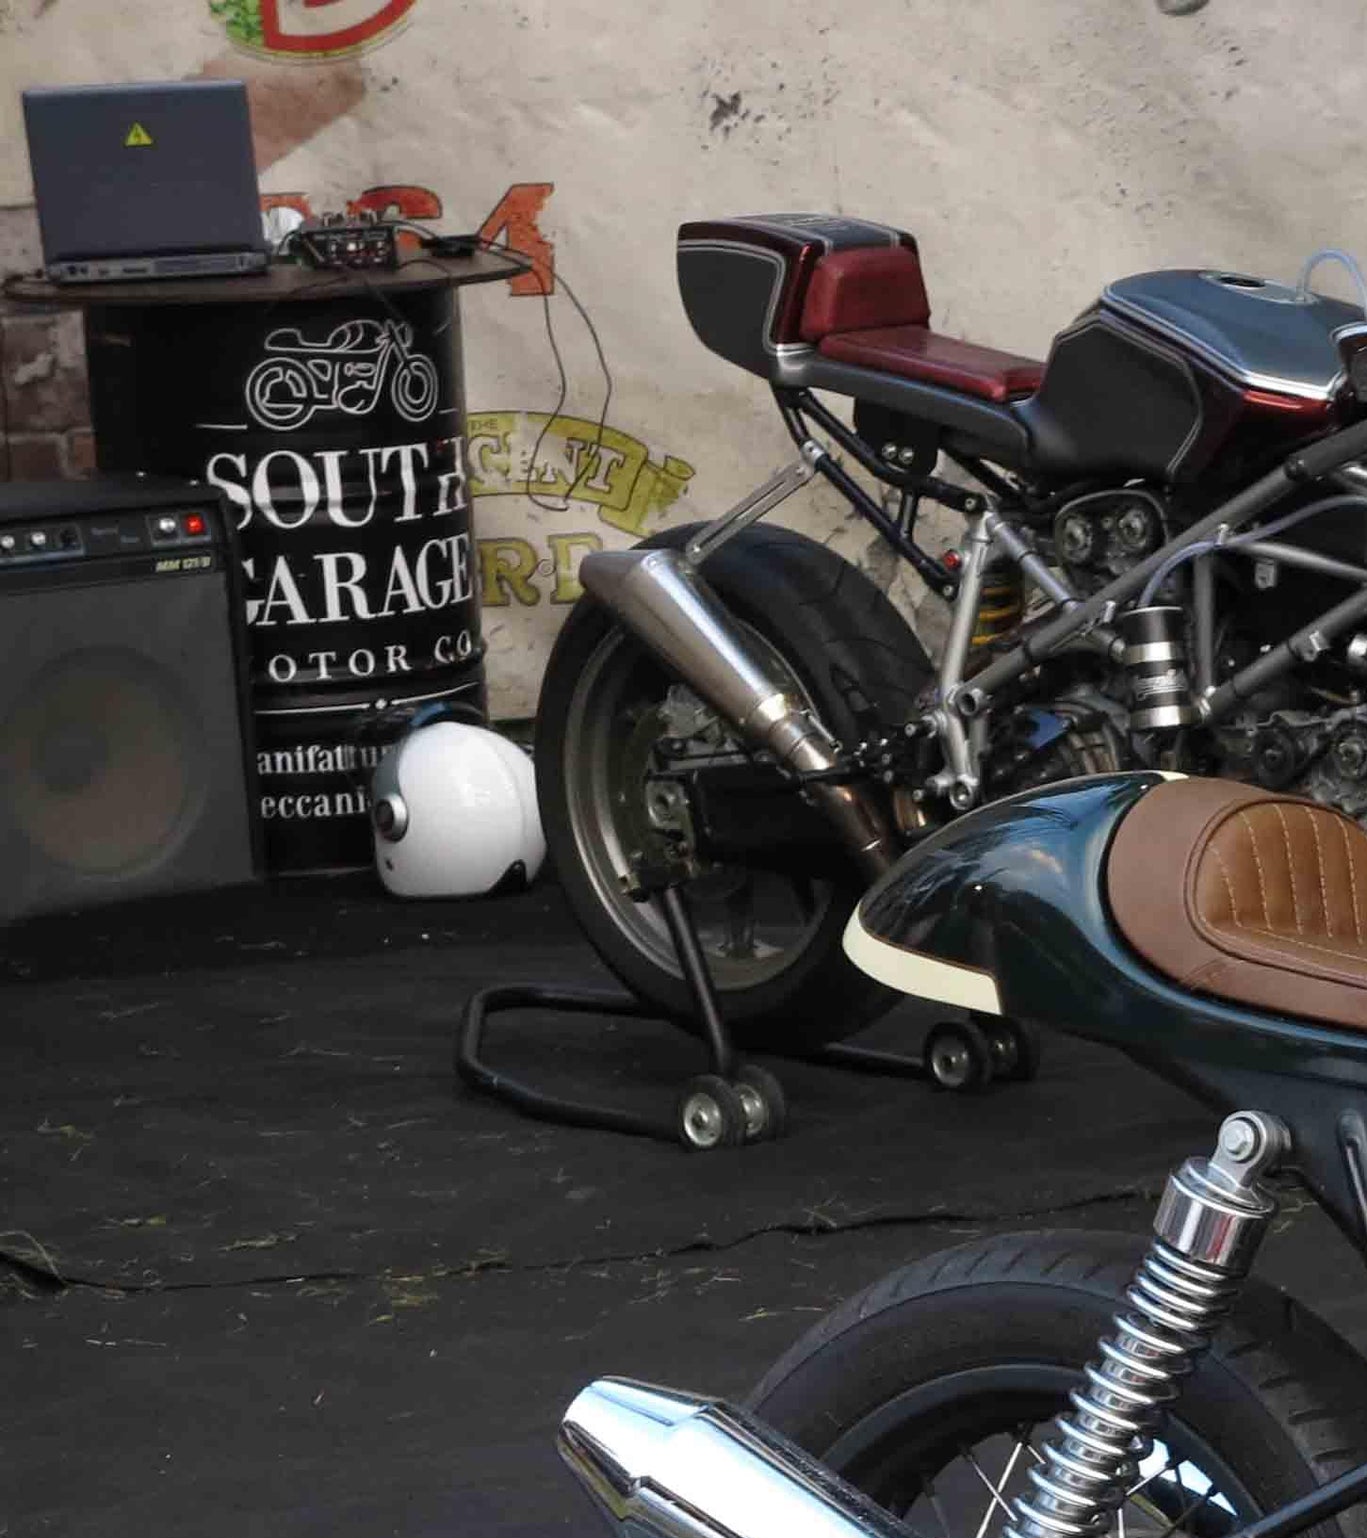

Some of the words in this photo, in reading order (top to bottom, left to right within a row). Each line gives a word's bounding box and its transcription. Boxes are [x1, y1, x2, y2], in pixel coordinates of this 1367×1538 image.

[206, 436, 468, 531] SOUTH
[268, 644, 412, 683] OTOR
[257, 744, 394, 776] anifattu
[261, 784, 372, 820] eccani
